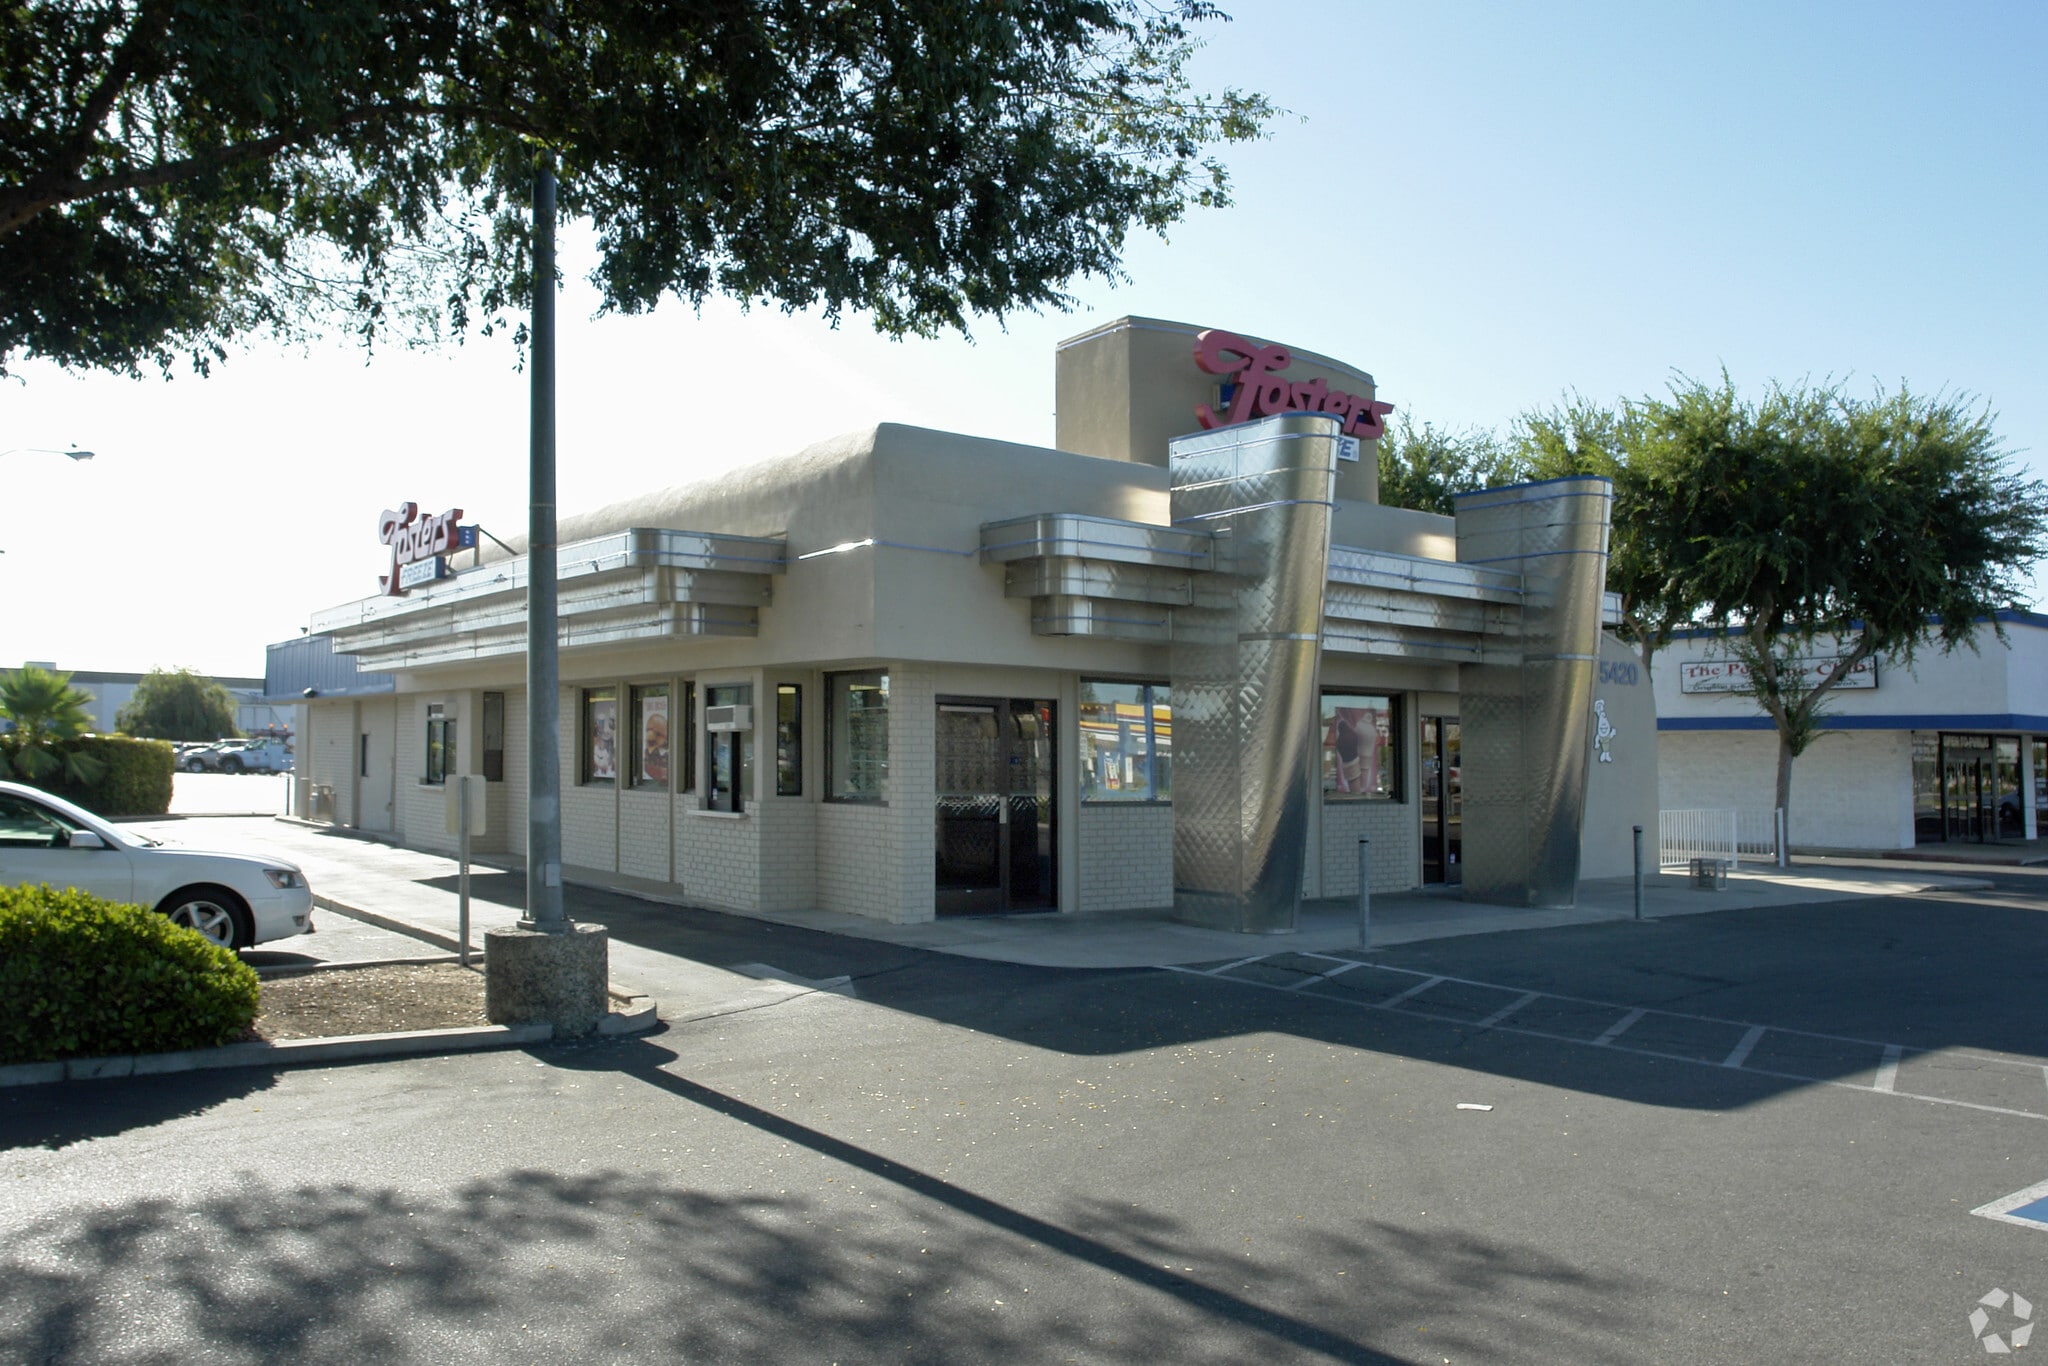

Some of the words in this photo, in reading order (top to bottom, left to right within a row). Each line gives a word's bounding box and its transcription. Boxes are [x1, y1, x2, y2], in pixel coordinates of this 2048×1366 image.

[1193, 329, 1395, 438] Fosters
[379, 502, 463, 596] Fosters
[1600, 661, 1638, 686] 5420
[1684, 665, 1721, 679] The
